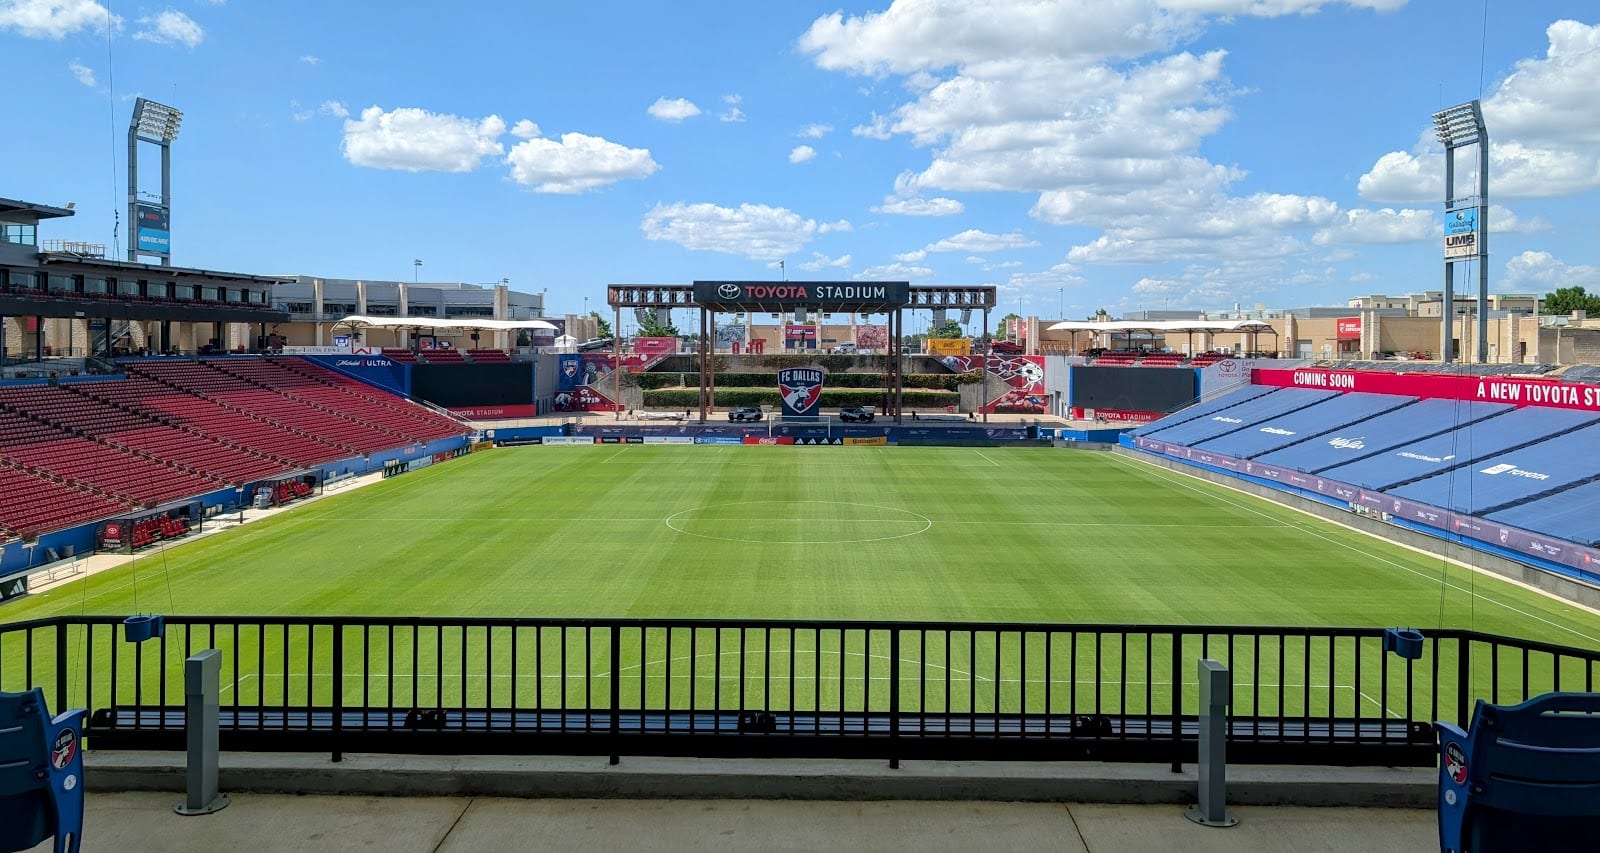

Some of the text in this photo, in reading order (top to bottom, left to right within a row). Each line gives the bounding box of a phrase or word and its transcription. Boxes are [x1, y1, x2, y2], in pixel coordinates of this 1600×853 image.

[1446, 234, 1475, 246] UMB
[745, 285, 885, 299] TOYOTA STADIUM
[781, 370, 820, 382] FC DALLAS
[1293, 371, 1355, 388] COMING SOON
[1477, 381, 1486, 398] A
[1490, 382, 1520, 401] NEW
[1525, 384, 1579, 405] TOYOTA
[476, 408, 504, 416] STADIUM
[1096, 411, 1120, 419] TOYOTA
